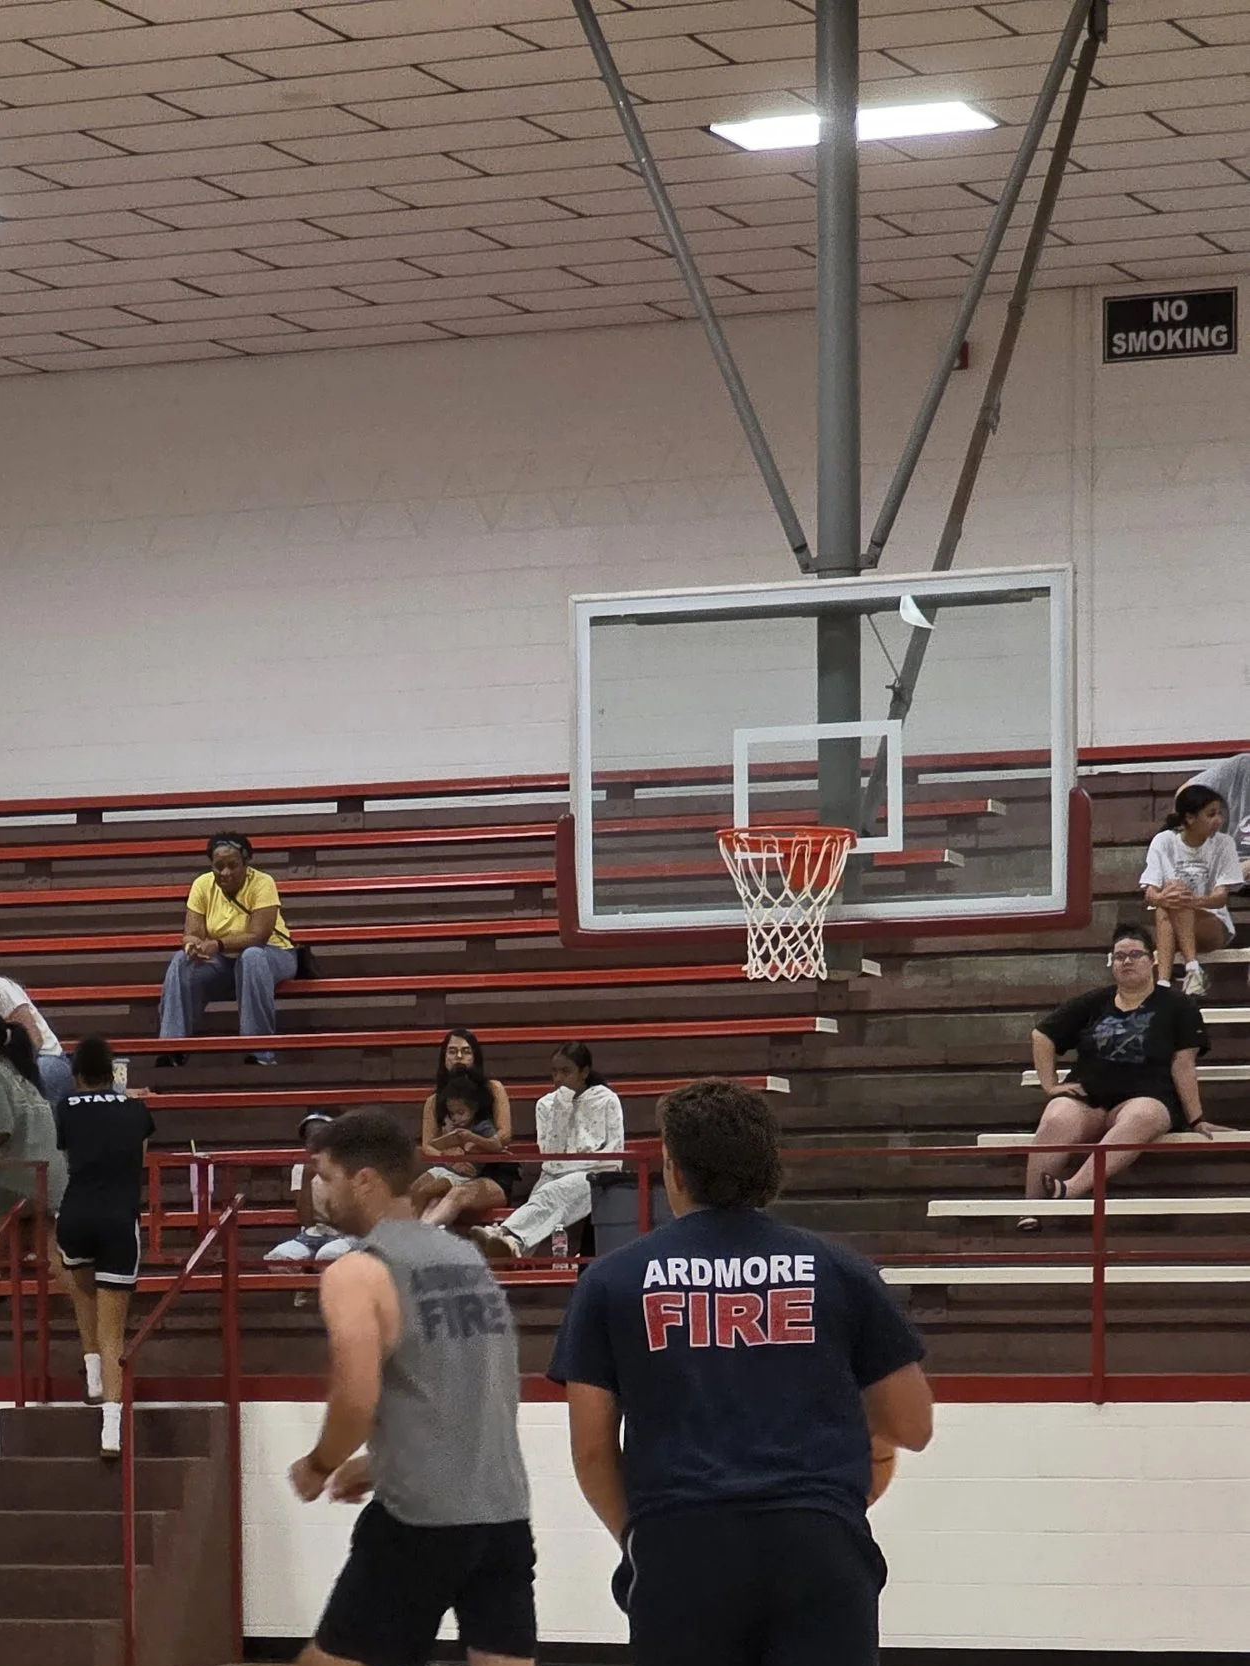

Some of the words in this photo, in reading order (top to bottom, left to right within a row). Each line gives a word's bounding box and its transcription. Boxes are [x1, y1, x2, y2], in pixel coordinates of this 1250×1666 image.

[1152, 300, 1188, 322] NO
[1112, 325, 1228, 354] SMOKING
[68, 1094, 127, 1105] STAFF
[643, 1255, 815, 1288] ARDMORE
[419, 1294, 507, 1342] FIRE
[643, 1288, 815, 1351] FIRE
